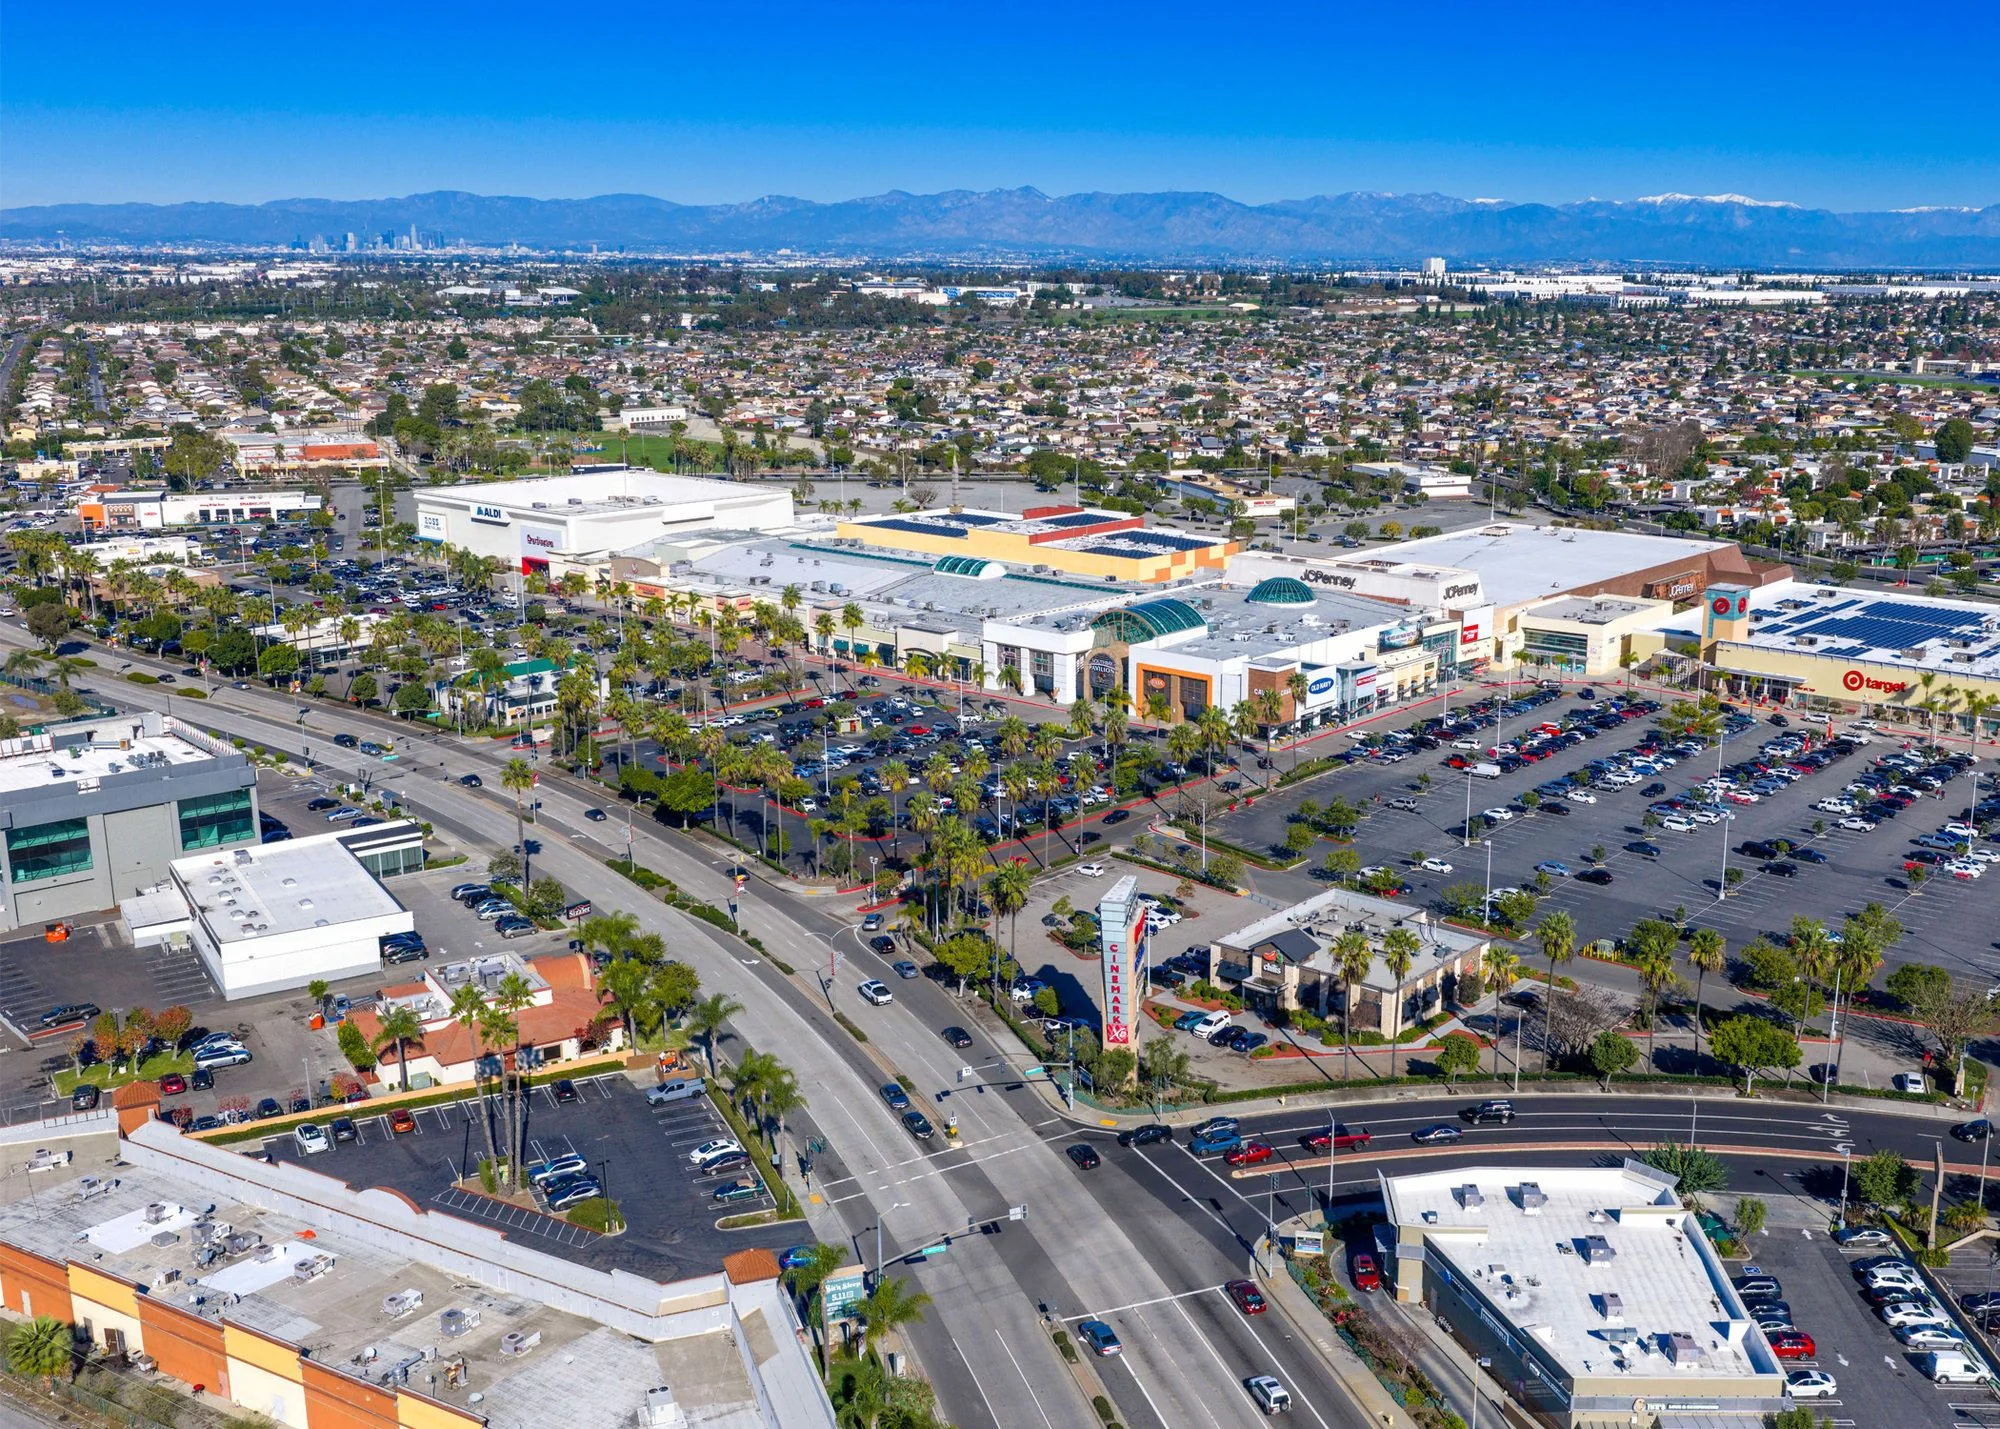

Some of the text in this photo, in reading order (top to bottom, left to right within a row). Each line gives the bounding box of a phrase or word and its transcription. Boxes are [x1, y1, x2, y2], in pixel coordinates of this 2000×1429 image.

[484, 507, 501, 519] ALDI
[1300, 568, 1357, 590] JCPenney
[1443, 582, 1479, 600] JCPenney
[1311, 680, 1332, 692] OLD NAVY
[1865, 676, 1906, 693] target
[1109, 944, 1121, 1024] CINEMARK
